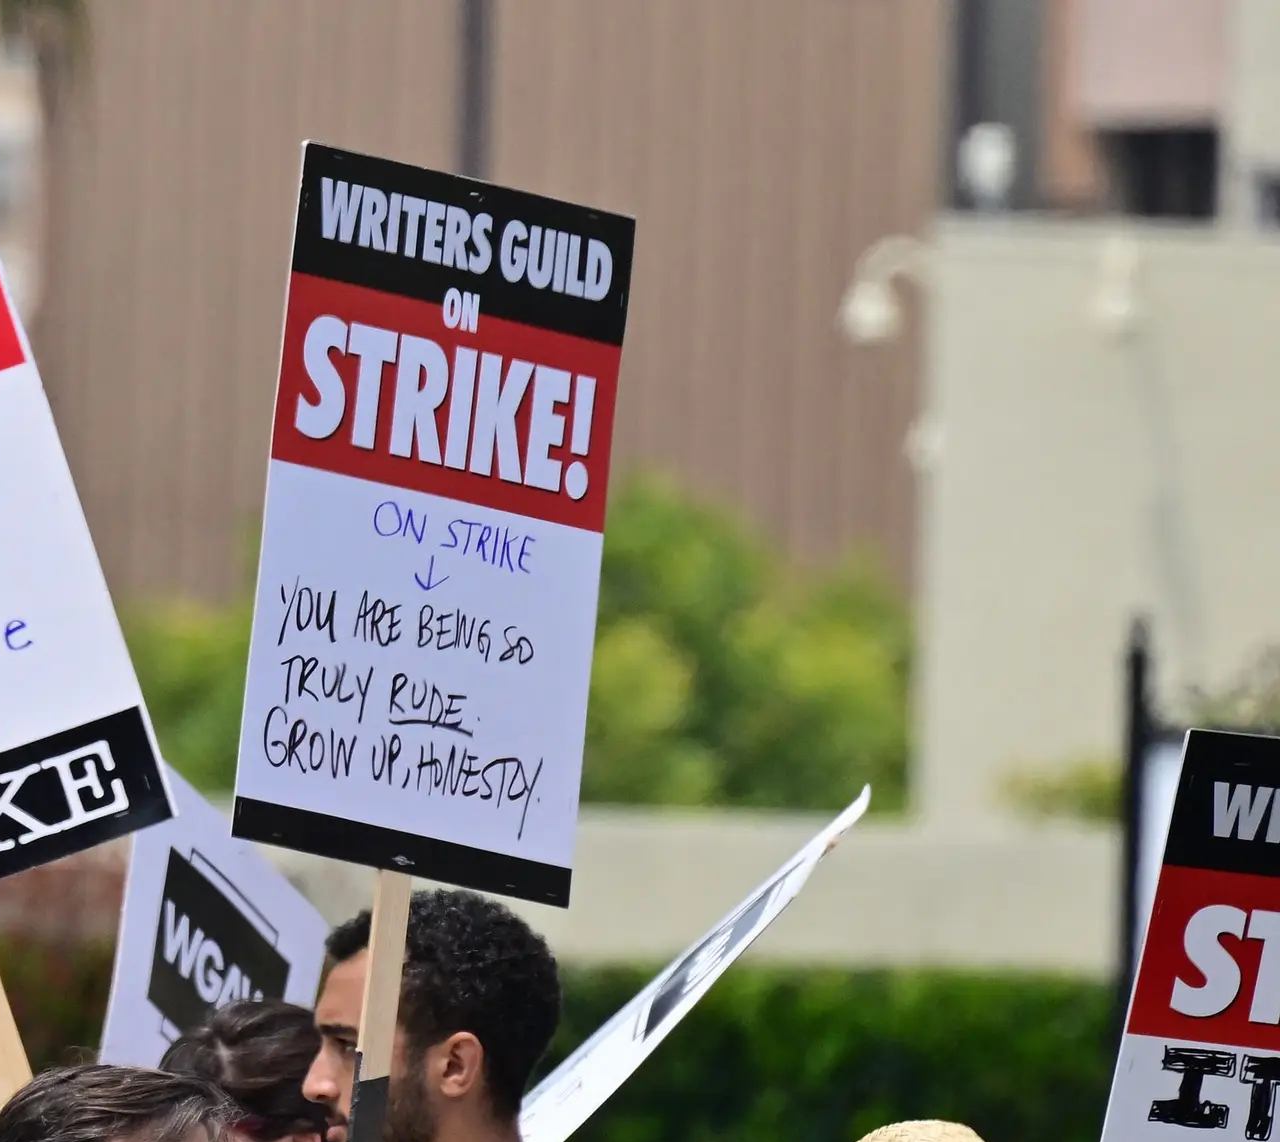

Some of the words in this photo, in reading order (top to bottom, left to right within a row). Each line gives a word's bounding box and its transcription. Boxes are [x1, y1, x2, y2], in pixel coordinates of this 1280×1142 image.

[320, 177, 492, 275] WRITERS
[500, 221, 612, 301] GUILD
[443, 287, 480, 334] ON
[294, 313, 597, 501] STRIKE!
[374, 500, 428, 546] ON
[440, 521, 535, 574] STRIKE
[278, 576, 337, 646] YOU
[354, 590, 402, 647] ARE
[417, 604, 491, 662] BEING
[499, 626, 534, 664] SO
[281, 655, 374, 724] TRULY
[264, 706, 357, 778] GROW
[163, 899, 264, 1010] WGA
